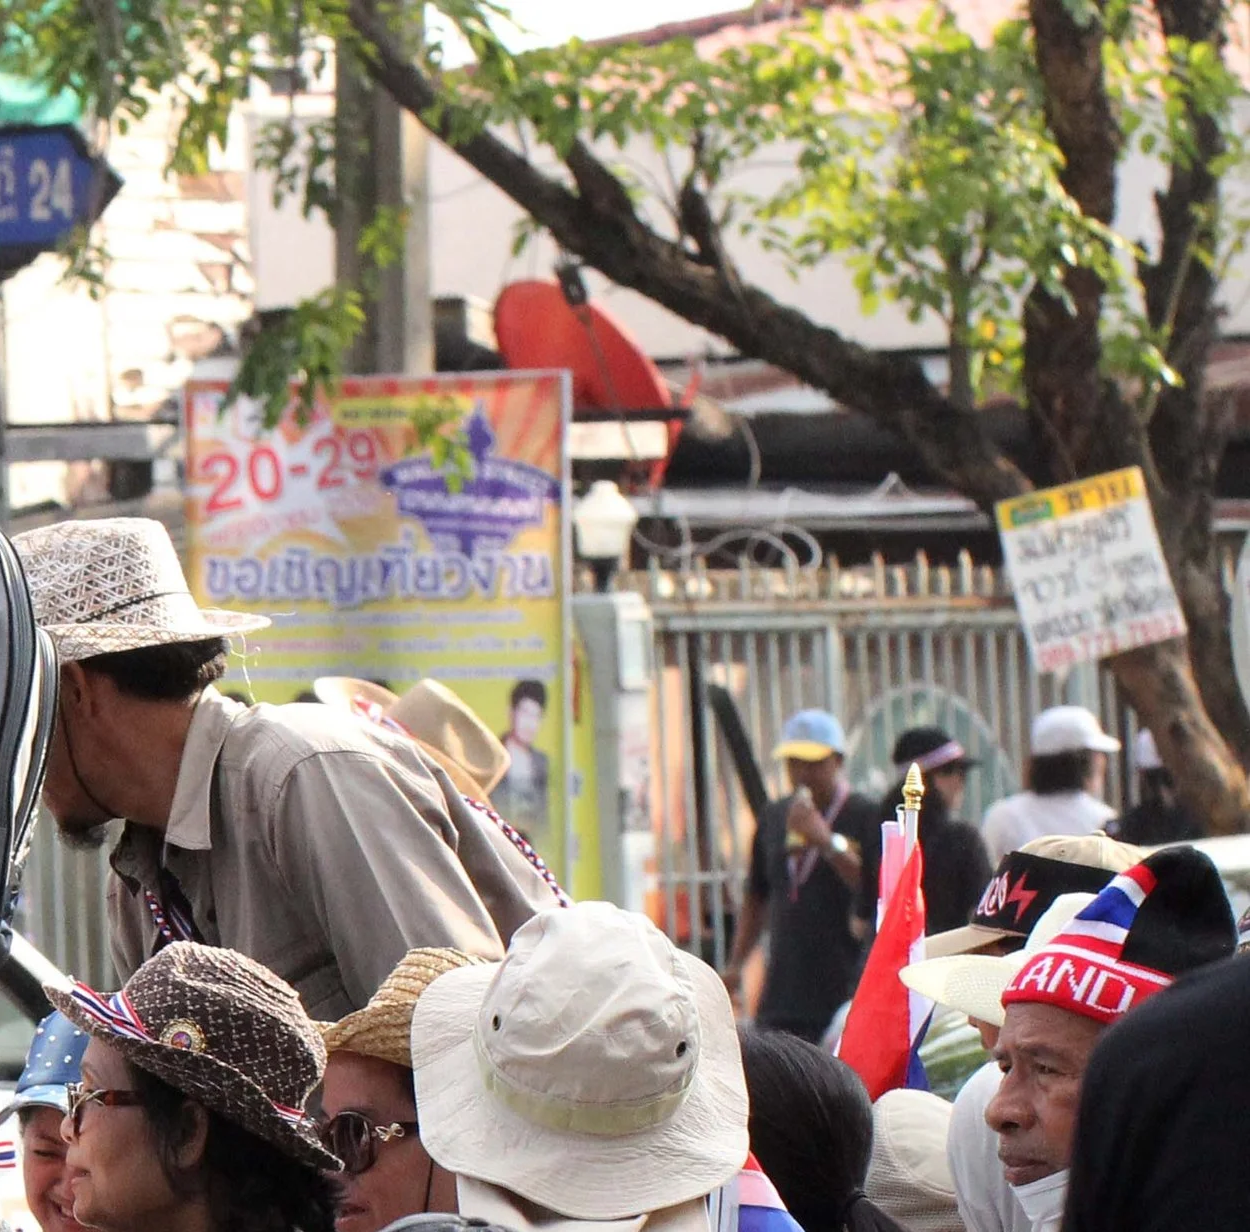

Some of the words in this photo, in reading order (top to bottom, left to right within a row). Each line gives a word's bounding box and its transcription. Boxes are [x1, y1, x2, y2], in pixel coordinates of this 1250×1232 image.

[29, 159, 74, 221] 24
[200, 432, 378, 514] 20-29
[206, 530, 551, 603] ขอเชิญเที่ยวงาน
